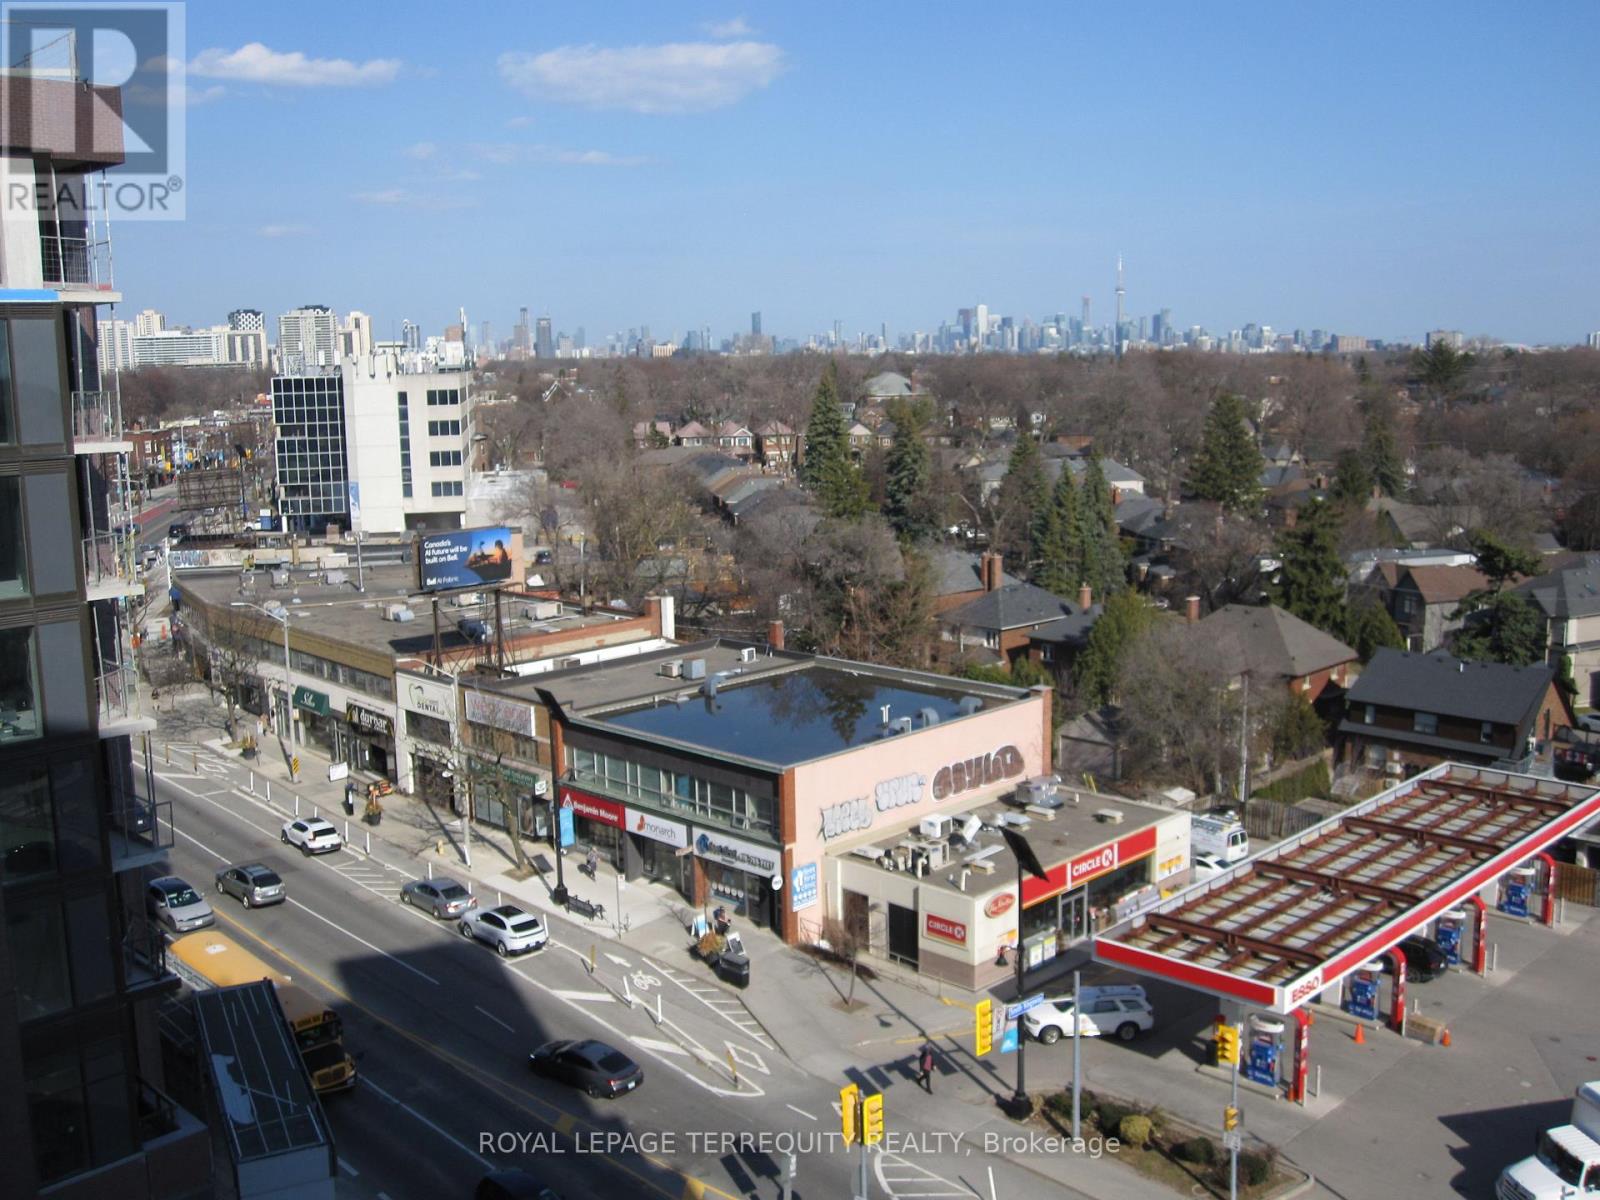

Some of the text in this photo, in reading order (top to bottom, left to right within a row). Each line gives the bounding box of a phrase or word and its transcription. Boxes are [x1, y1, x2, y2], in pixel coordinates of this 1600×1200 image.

[424, 540, 451, 549] Canada's
[432, 547, 449, 556] future
[425, 556, 439, 564] built
[426, 578, 436, 586] Bell
[417, 702, 439, 713] DENTAL
[574, 800, 618, 822] Benjamin Moore
[644, 822, 676, 839] monarch
[1072, 848, 1112, 878] CIRCLE K
[928, 920, 964, 939] CIRCLE K
